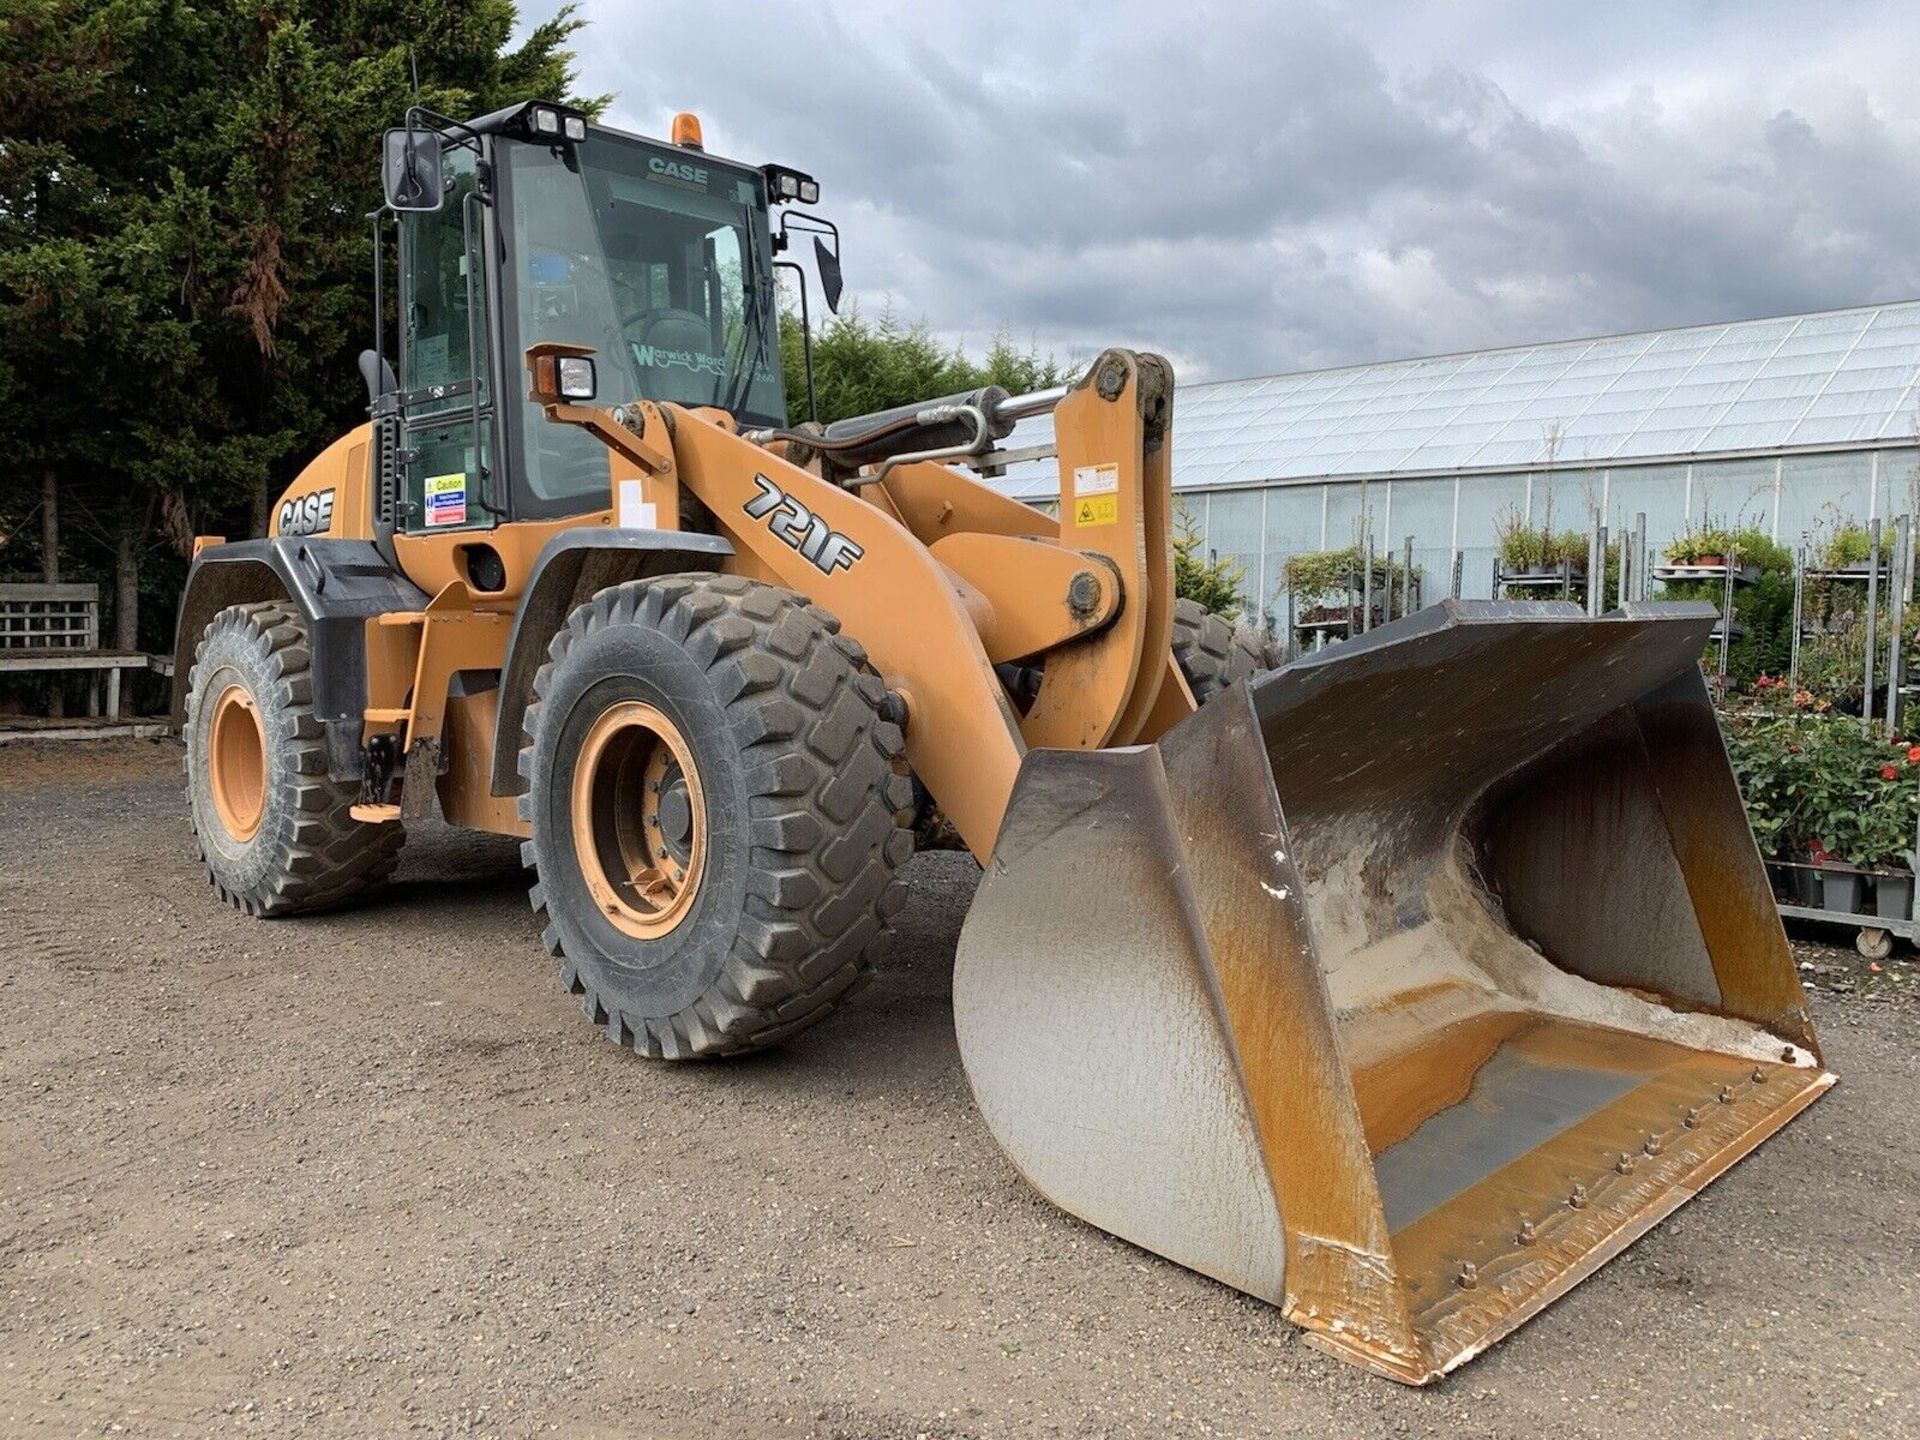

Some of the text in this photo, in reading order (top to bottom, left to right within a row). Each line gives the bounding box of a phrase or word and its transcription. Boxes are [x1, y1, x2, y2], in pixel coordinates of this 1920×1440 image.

[648, 157, 708, 185] CASE
[631, 343, 693, 367] Warwick
[437, 480, 462, 491] Caution
[278, 487, 336, 537] CASE
[742, 472, 865, 576] 721F
